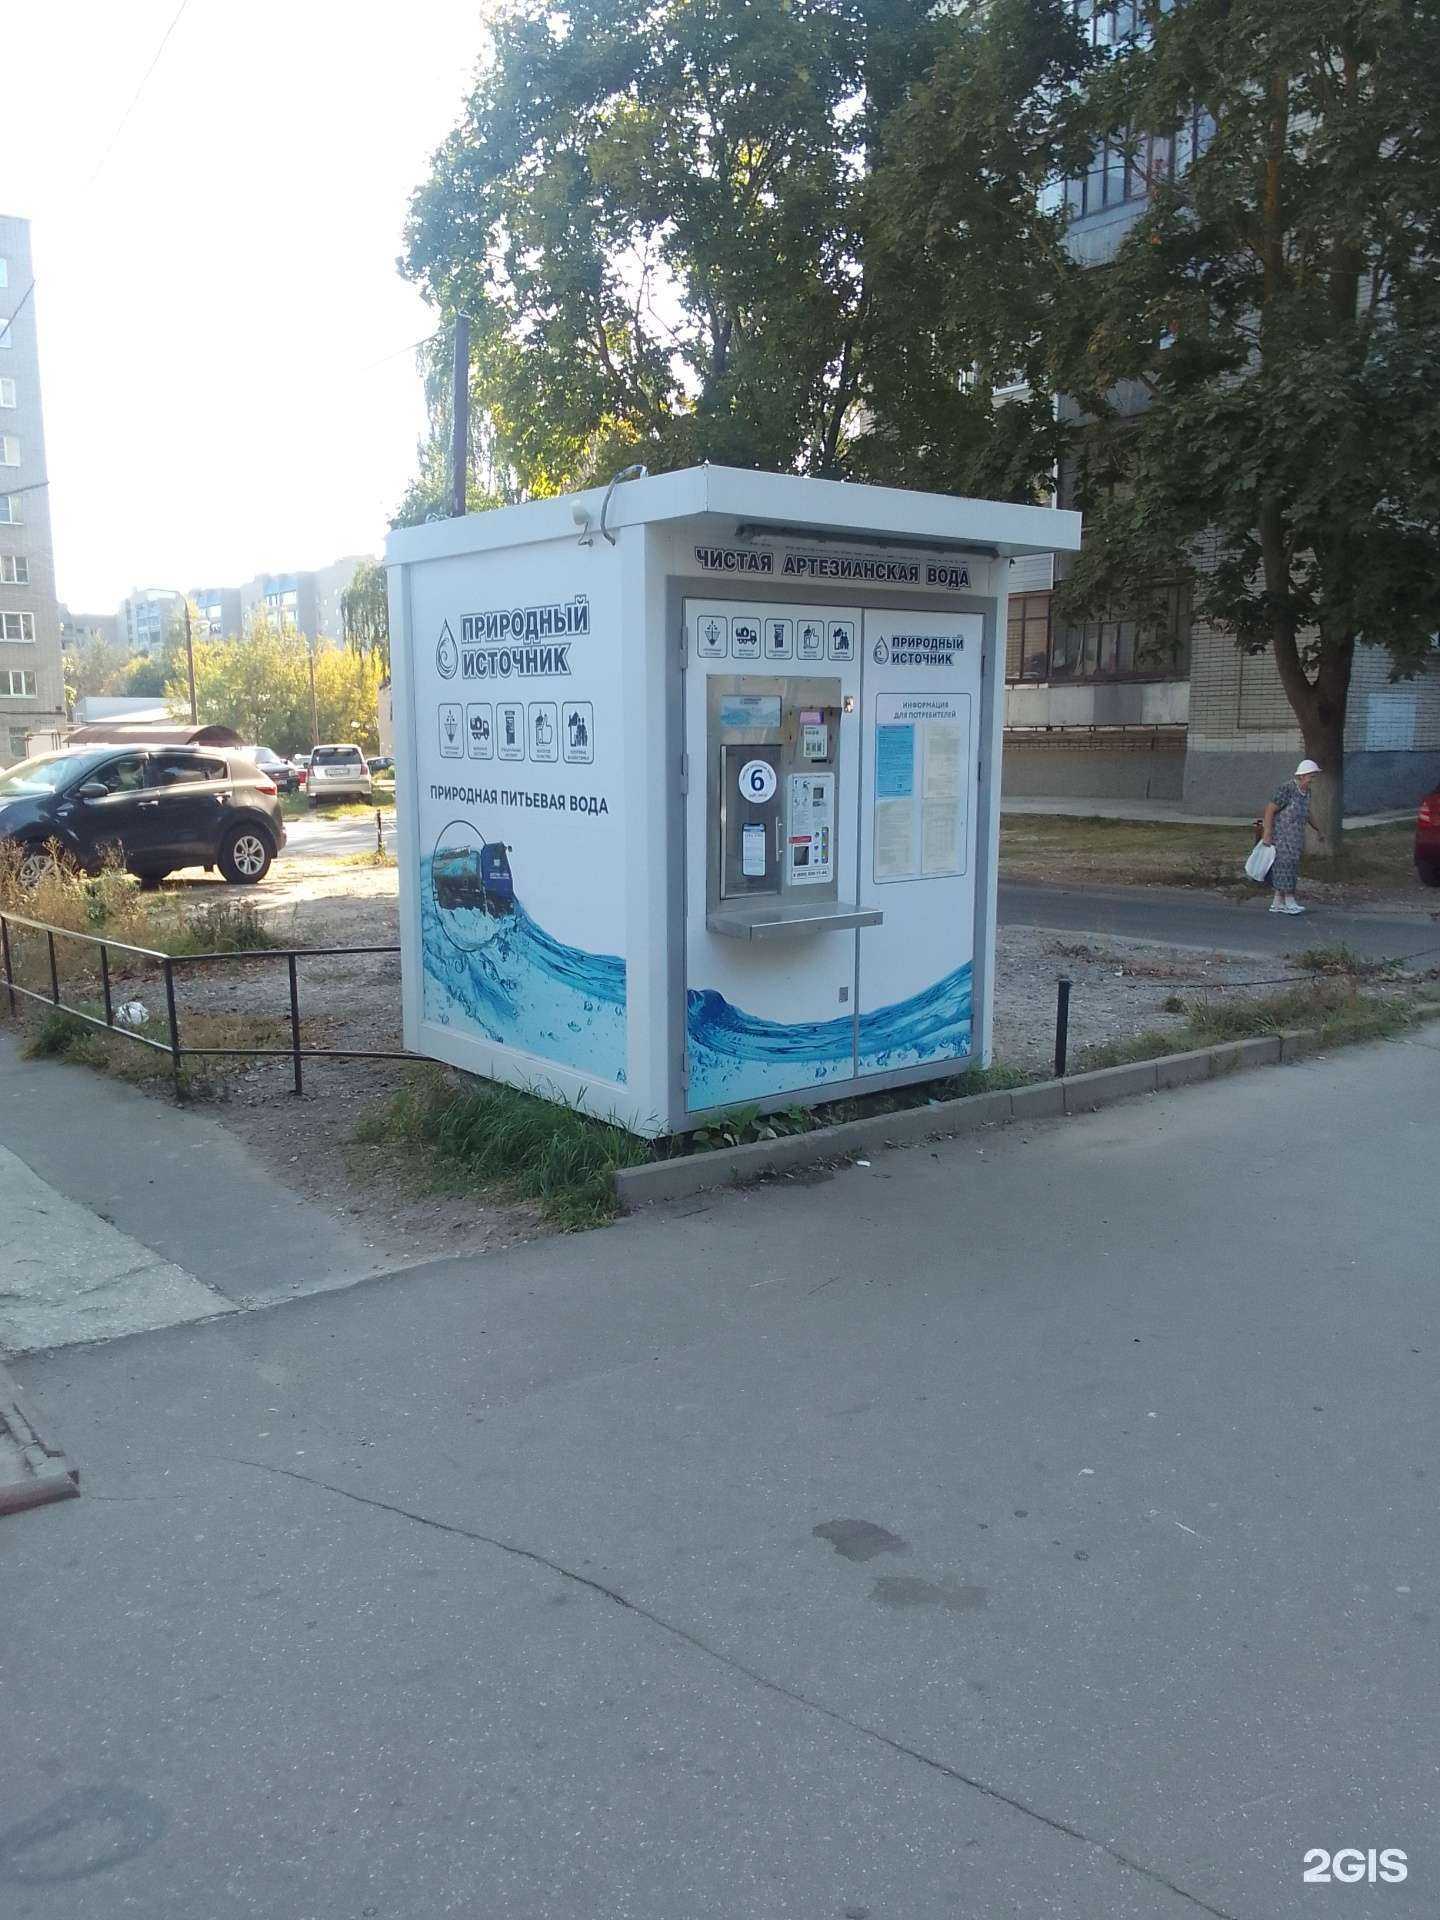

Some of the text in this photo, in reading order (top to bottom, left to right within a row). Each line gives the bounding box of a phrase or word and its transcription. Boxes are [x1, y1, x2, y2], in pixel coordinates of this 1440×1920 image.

[695, 547, 971, 590] ЧИСТАЯ АРТЕЗИАНСКАЯ ВОДА
[461, 595, 589, 644] ПРИРОДНЫЙ
[891, 634, 964, 652] ПРИРОДНЫЙ
[462, 644, 571, 679] ИСТОЧНИК
[891, 652, 954, 666] ИСТОЧНИК
[893, 710, 957, 720] ДЛЯ ПОТРЕБИТЕЛЕЙ
[902, 701, 949, 710] ИНФОРМАЦИЯ
[750, 768, 765, 792] 6
[430, 784, 609, 816] ПРИРОДНАЯ ПИТЬЕВАЯ ВОДА
